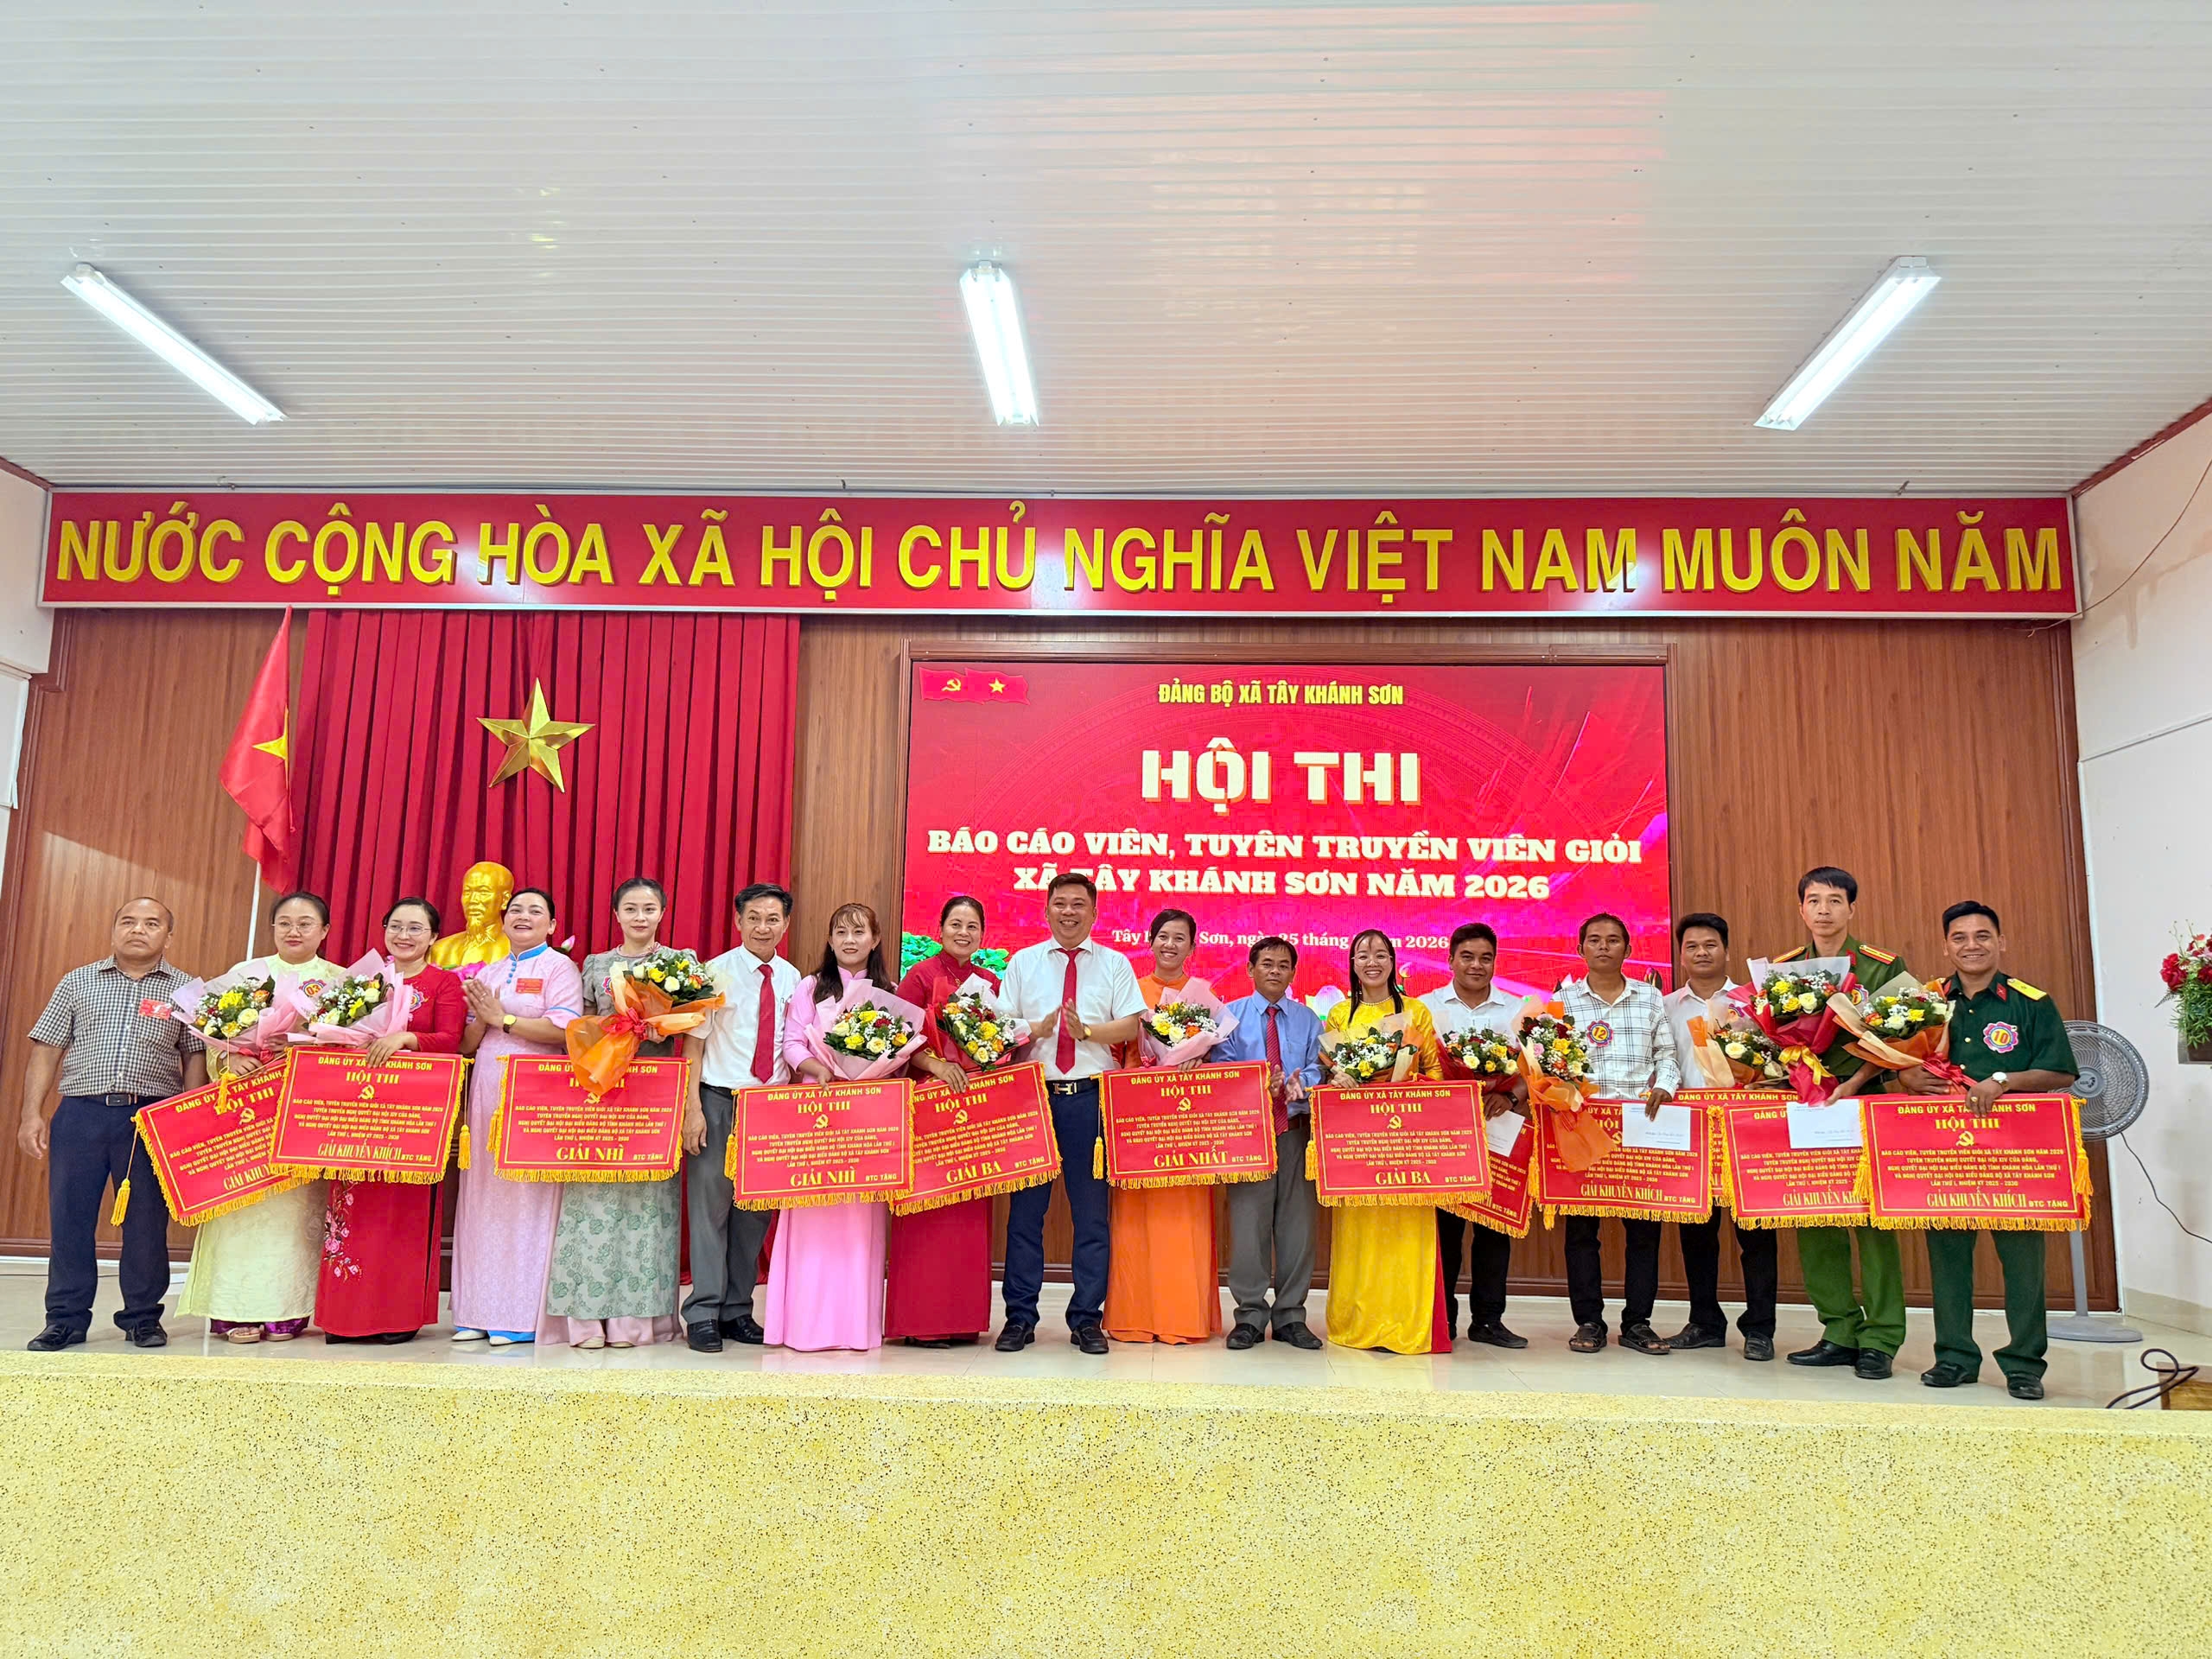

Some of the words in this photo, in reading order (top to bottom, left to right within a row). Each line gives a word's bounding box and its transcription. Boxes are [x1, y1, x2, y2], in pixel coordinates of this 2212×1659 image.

[56, 499, 245, 584] NƯỚC
[264, 504, 459, 597] CỘNG
[477, 504, 614, 587] HÒA
[638, 507, 736, 587] XÃ
[760, 507, 874, 602] HỘI
[896, 499, 1038, 590] CHỦ
[1062, 512, 1275, 593] NGHĨA
[1296, 510, 1454, 607] VIỆT
[1480, 526, 1638, 593] NAM
[1661, 508, 1875, 594] MUÔN
[1896, 510, 2063, 594] NĂM
[1158, 678, 1205, 703] ĐẢNG
[1211, 680, 1233, 707] BỘ
[1239, 680, 1262, 703] XÃ
[1267, 680, 1299, 704] TÂY
[1305, 680, 1363, 704] KHÁNH
[1368, 683, 1403, 705] SƠN
[1141, 737, 1272, 815] HỘI
[1294, 752, 1421, 806] THI
[928, 828, 999, 855] BÁO
[1006, 827, 1076, 855] CÁO
[1084, 828, 1176, 861] VIÊN,
[1184, 830, 1303, 858] TUYÊN
[1313, 830, 1459, 861] TRUYỀN
[1467, 833, 1555, 862] VIÊN
[1565, 832, 1642, 863] GIỎI
[1014, 862, 1058, 890] XÃ
[1148, 866, 1275, 893] KHÁNH
[1285, 867, 1359, 896] SƠN
[1367, 868, 1456, 898] NĂM
[1465, 875, 1549, 899] 2026
[1112, 929, 1141, 945] Tây
[1199, 931, 1234, 947] Sơn,
[1302, 931, 1349, 949] tháng
[1406, 936, 1449, 948] 2026
[307, 984, 321, 995] 03
[1594, 1027, 1606, 1039] 12
[1994, 1031, 2009, 1044] 10
[318, 1056, 340, 1065] ĐẢNG
[343, 1056, 353, 1066] ỦY
[356, 1058, 365, 1066] XÃ
[385, 1059, 413, 1070] KHÁNH
[416, 1060, 432, 1071] SƠN
[538, 1063, 562, 1072] ĐẢNG
[641, 1065, 658, 1074] SƠN
[346, 1070, 372, 1085] HỘI
[376, 1073, 399, 1084] THI
[1131, 1076, 1152, 1085] ĐẢNG
[1154, 1074, 1165, 1084] ỦY
[1167, 1074, 1177, 1083] XÃ
[1179, 1072, 1193, 1081] TÂY
[1196, 1071, 1222, 1080] KHÁNH
[175, 1099, 201, 1113] ĐẢNG
[203, 1093, 216, 1103] ỦY
[232, 1082, 249, 1093] TÂY
[251, 1071, 283, 1087] KHÁNH
[247, 1087, 275, 1103] THI
[767, 1091, 789, 1101] ĐẢNG
[792, 1090, 803, 1100] ỦY
[805, 1089, 816, 1099] XÃ
[836, 1087, 863, 1096] KHÁNH
[865, 1087, 881, 1096] SƠN
[927, 1090, 938, 1100] ỦY
[940, 1087, 950, 1096] XÃ
[969, 1077, 996, 1090] KHÁNH
[998, 1074, 1014, 1084] SƠN
[1160, 1084, 1185, 1099] HỘI
[1189, 1084, 1211, 1095] THI
[1339, 1091, 1362, 1100] ĐẢNG
[1364, 1090, 1375, 1099] ỦY
[1376, 1090, 1387, 1099] XÃ
[1406, 1090, 1433, 1098] KHÁNH
[934, 1098, 961, 1113] HỘI
[963, 1093, 988, 1106] THI
[1678, 1092, 1701, 1101] ĐẢNG
[1704, 1092, 1715, 1101] ỦY
[1717, 1091, 1728, 1100] XÃ
[1749, 1092, 1778, 1101] KHÁNH
[798, 1101, 823, 1116] HỘI
[827, 1101, 850, 1111] THI
[1370, 1102, 1395, 1116] HỘI
[1400, 1103, 1422, 1113] THI
[1754, 1110, 1777, 1120] ĐẢNG
[1897, 1103, 1923, 1114] ĐẢNG
[1927, 1103, 1939, 1114] ỦY
[1942, 1104, 1955, 1113] XÃ
[2015, 1103, 2036, 1112] SƠN
[1936, 1116, 1966, 1132] HỘI
[1969, 1118, 2000, 1128] THI
[318, 1140, 335, 1157] GIẢI
[338, 1139, 372, 1159] KHUYẾN
[373, 1143, 402, 1160] KHÍCH
[556, 1143, 589, 1161] GIẢI
[594, 1144, 625, 1161] NHÌ
[1154, 1149, 1184, 1167] GIẢI
[1188, 1145, 1228, 1166] NHẤT
[245, 1164, 270, 1182] KHUY
[790, 1168, 822, 1187] GIẢI
[827, 1166, 856, 1184] NHÌ
[946, 1161, 977, 1184] GIẢI
[982, 1160, 1002, 1176] BA
[1375, 1168, 1406, 1185] GIẢI
[1410, 1171, 1432, 1184] BA
[1580, 1180, 1598, 1197] GIẢI
[1599, 1179, 1633, 1199] KHUYẾN
[1635, 1184, 1663, 1202] KHÍCH
[1927, 1190, 1947, 1207] GIẢI
[1949, 1187, 1989, 1207] KHUYẾN
[1993, 1190, 2026, 1208] KHÍCH
